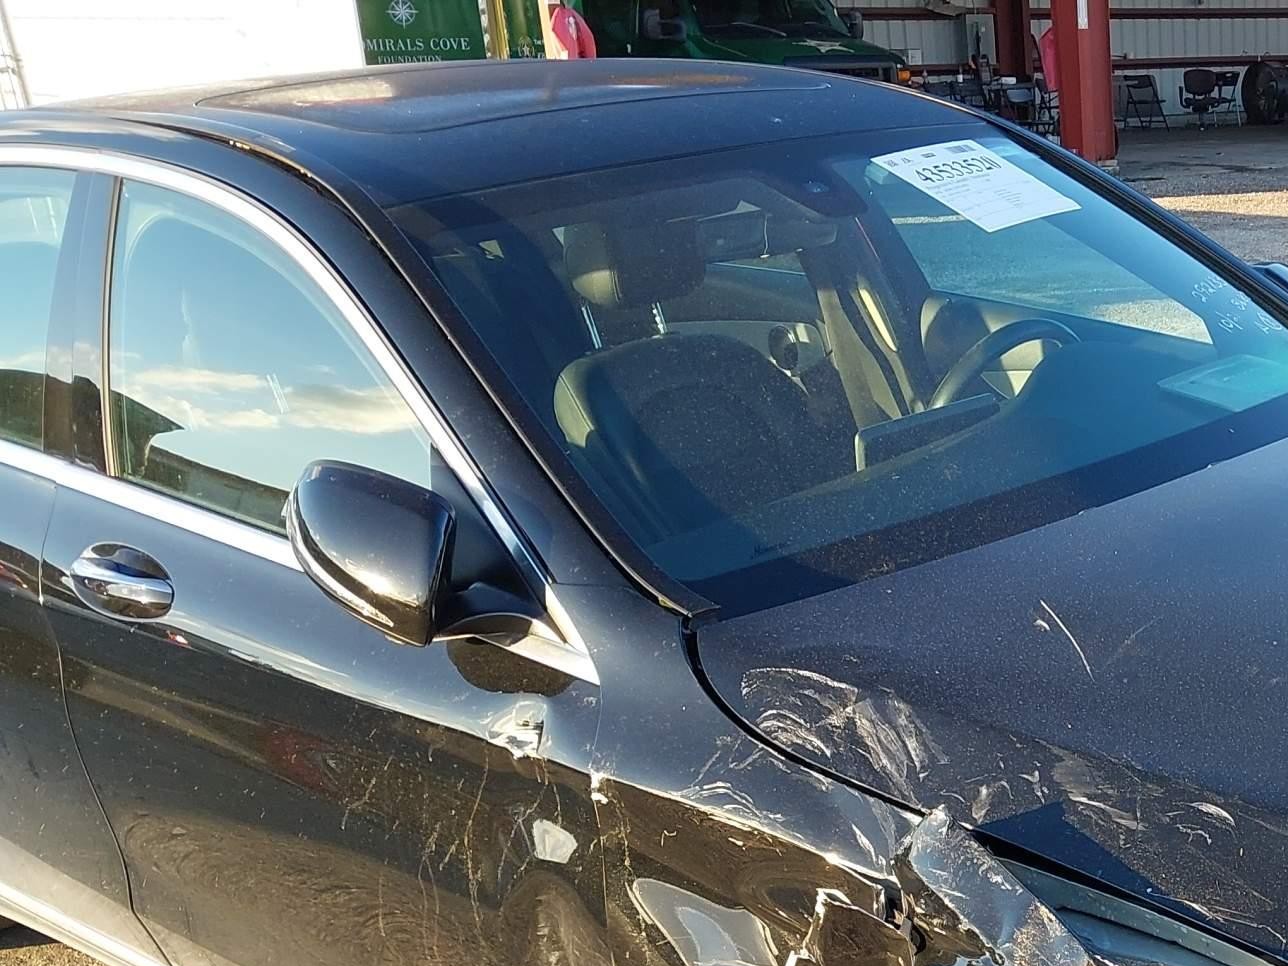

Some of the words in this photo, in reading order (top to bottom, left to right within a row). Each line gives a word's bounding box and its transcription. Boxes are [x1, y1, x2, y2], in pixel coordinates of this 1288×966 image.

[362, 38, 425, 51] MIRALS
[430, 37, 471, 50] COVE
[377, 54, 442, 65] FOUNDATION
[914, 155, 1002, 183] 43533520
